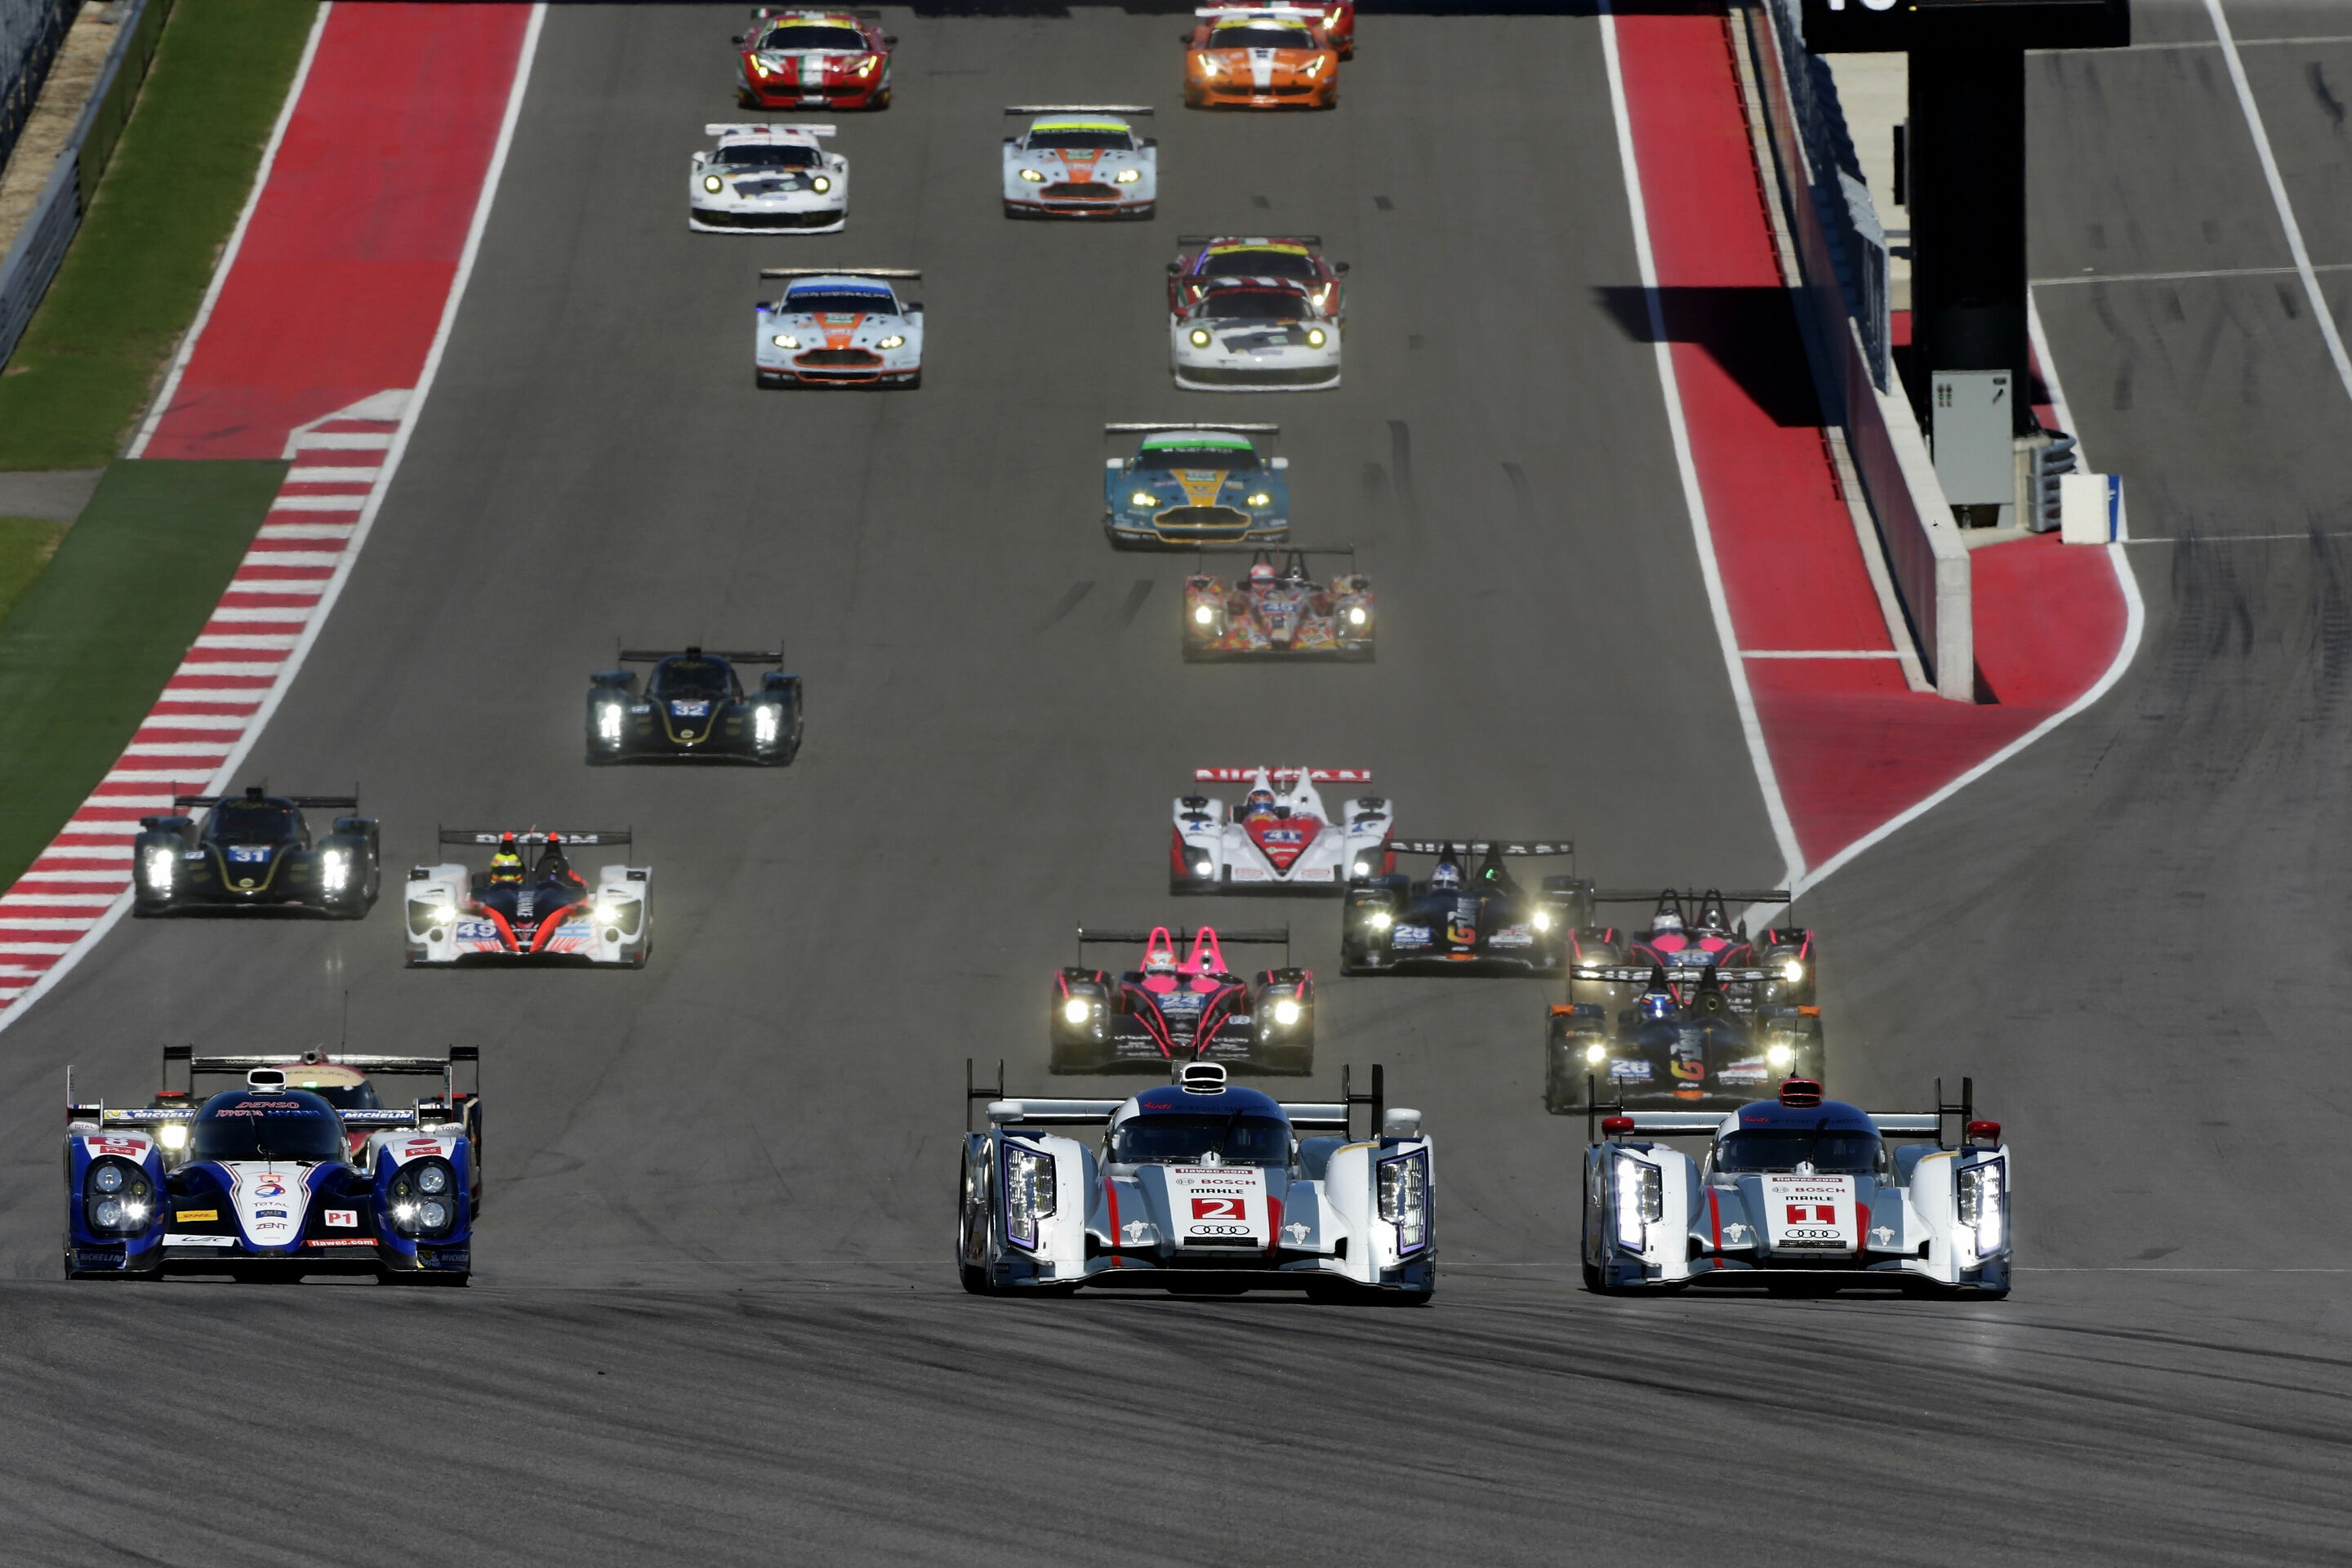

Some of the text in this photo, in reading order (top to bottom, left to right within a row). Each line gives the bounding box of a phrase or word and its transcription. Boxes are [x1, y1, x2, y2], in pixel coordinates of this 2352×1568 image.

[675, 706, 705, 716] 32
[235, 850, 264, 862] 31
[458, 923, 497, 938] 49
[1611, 1060, 1651, 1074] 26
[1143, 1102, 1173, 1110] Audi
[105, 1136, 129, 1147] 8
[1201, 1198, 1236, 1219] 2
[328, 1213, 351, 1224] P1
[1794, 1205, 1828, 1224] 1
[256, 1222, 288, 1231] ZENT
